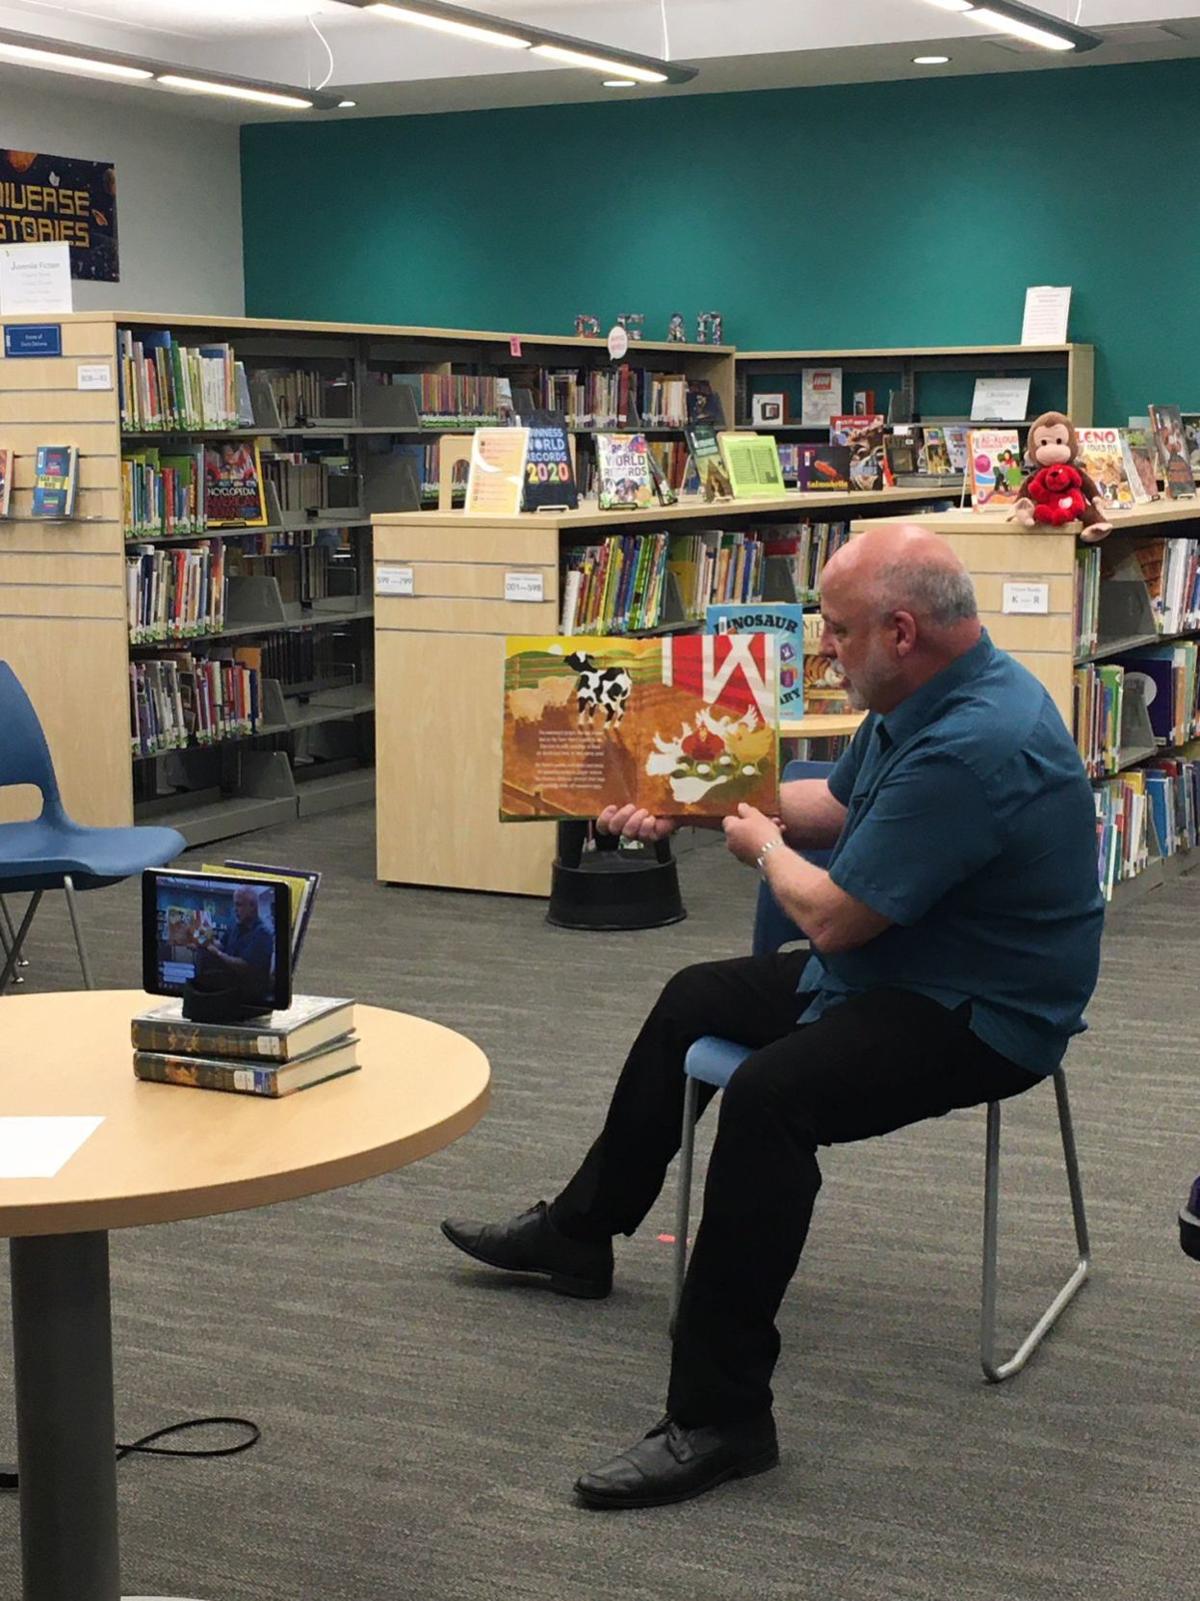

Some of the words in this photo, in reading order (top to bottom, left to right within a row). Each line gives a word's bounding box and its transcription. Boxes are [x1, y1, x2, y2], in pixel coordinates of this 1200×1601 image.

[528, 428, 564, 438] INNESS
[527, 463, 570, 484] 2020
[604, 467, 647, 477] RRDS
[208, 487, 256, 496] NCYCLOPEDIA
